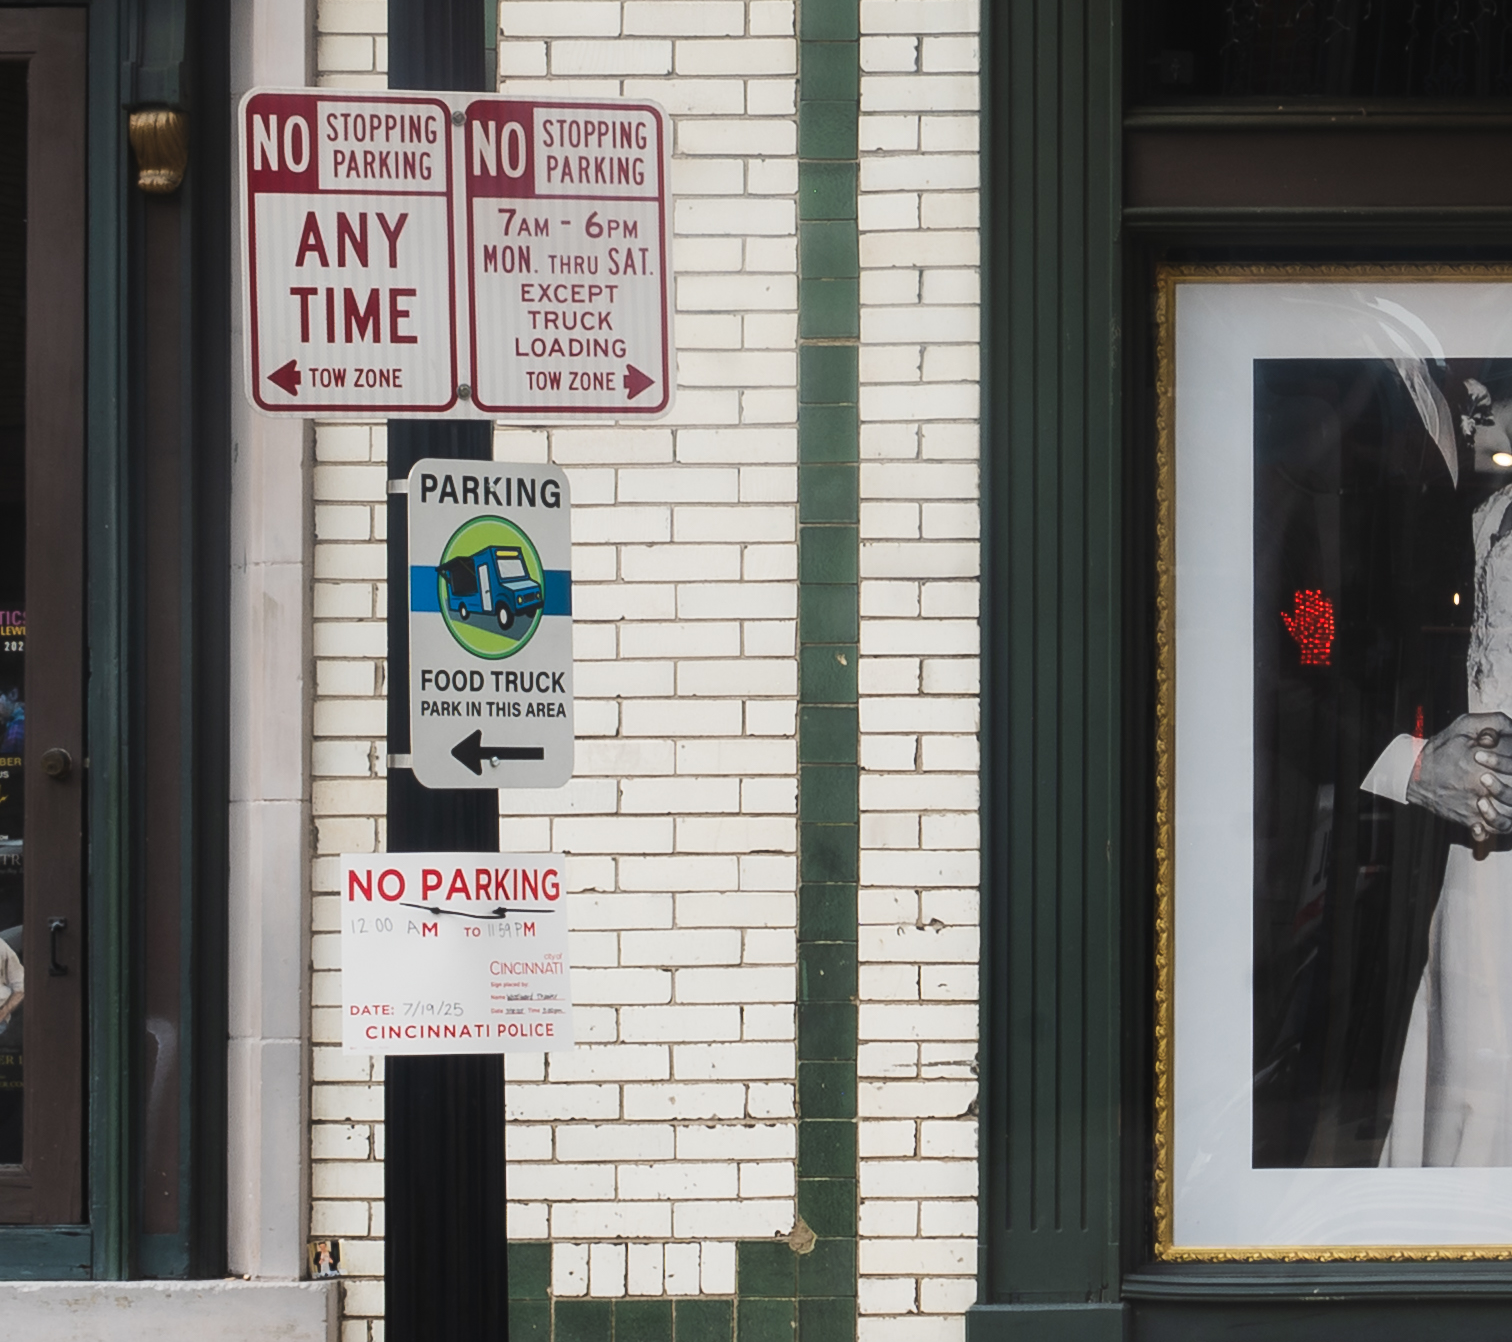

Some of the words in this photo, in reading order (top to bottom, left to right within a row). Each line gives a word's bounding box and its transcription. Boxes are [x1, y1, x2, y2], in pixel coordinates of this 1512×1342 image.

[253, 114, 311, 173] NO
[326, 113, 437, 144] STOPPING
[542, 119, 647, 150] STOPPING
[472, 119, 527, 178] NO
[333, 149, 432, 180] PARKING
[546, 156, 645, 186] PARKING
[497, 208, 549, 237] 7AM
[584, 210, 639, 239] 6PM
[295, 211, 408, 269] ANY
[483, 244, 539, 274] MON.
[548, 254, 599, 275] THRU
[607, 247, 654, 276] SAT.
[520, 283, 619, 304] EXCEPT
[290, 287, 418, 344] TIME
[527, 310, 613, 331] TRUCK
[515, 338, 627, 359] LOADING
[309, 367, 346, 388] TOW
[353, 368, 403, 388] ZONE
[526, 371, 563, 391] TOW
[568, 372, 616, 391] ZONE
[420, 473, 561, 509] PARKING
[421, 669, 484, 692] FOOD
[490, 670, 566, 694] TRUCK
[420, 701, 462, 717] PARK
[466, 702, 482, 717] IN
[486, 701, 521, 718] THIS
[525, 702, 566, 718] AREA
[348, 868, 406, 902] NO
[421, 868, 560, 901] PARKING
[464, 926, 481, 937] TO
[490, 960, 563, 975] CINCINNATI
[350, 1005, 394, 1016] DATE:
[403, 1001, 464, 1018] 7/19/25
[366, 1024, 490, 1039] CINCINNATI
[497, 1023, 554, 1037] POLICE
